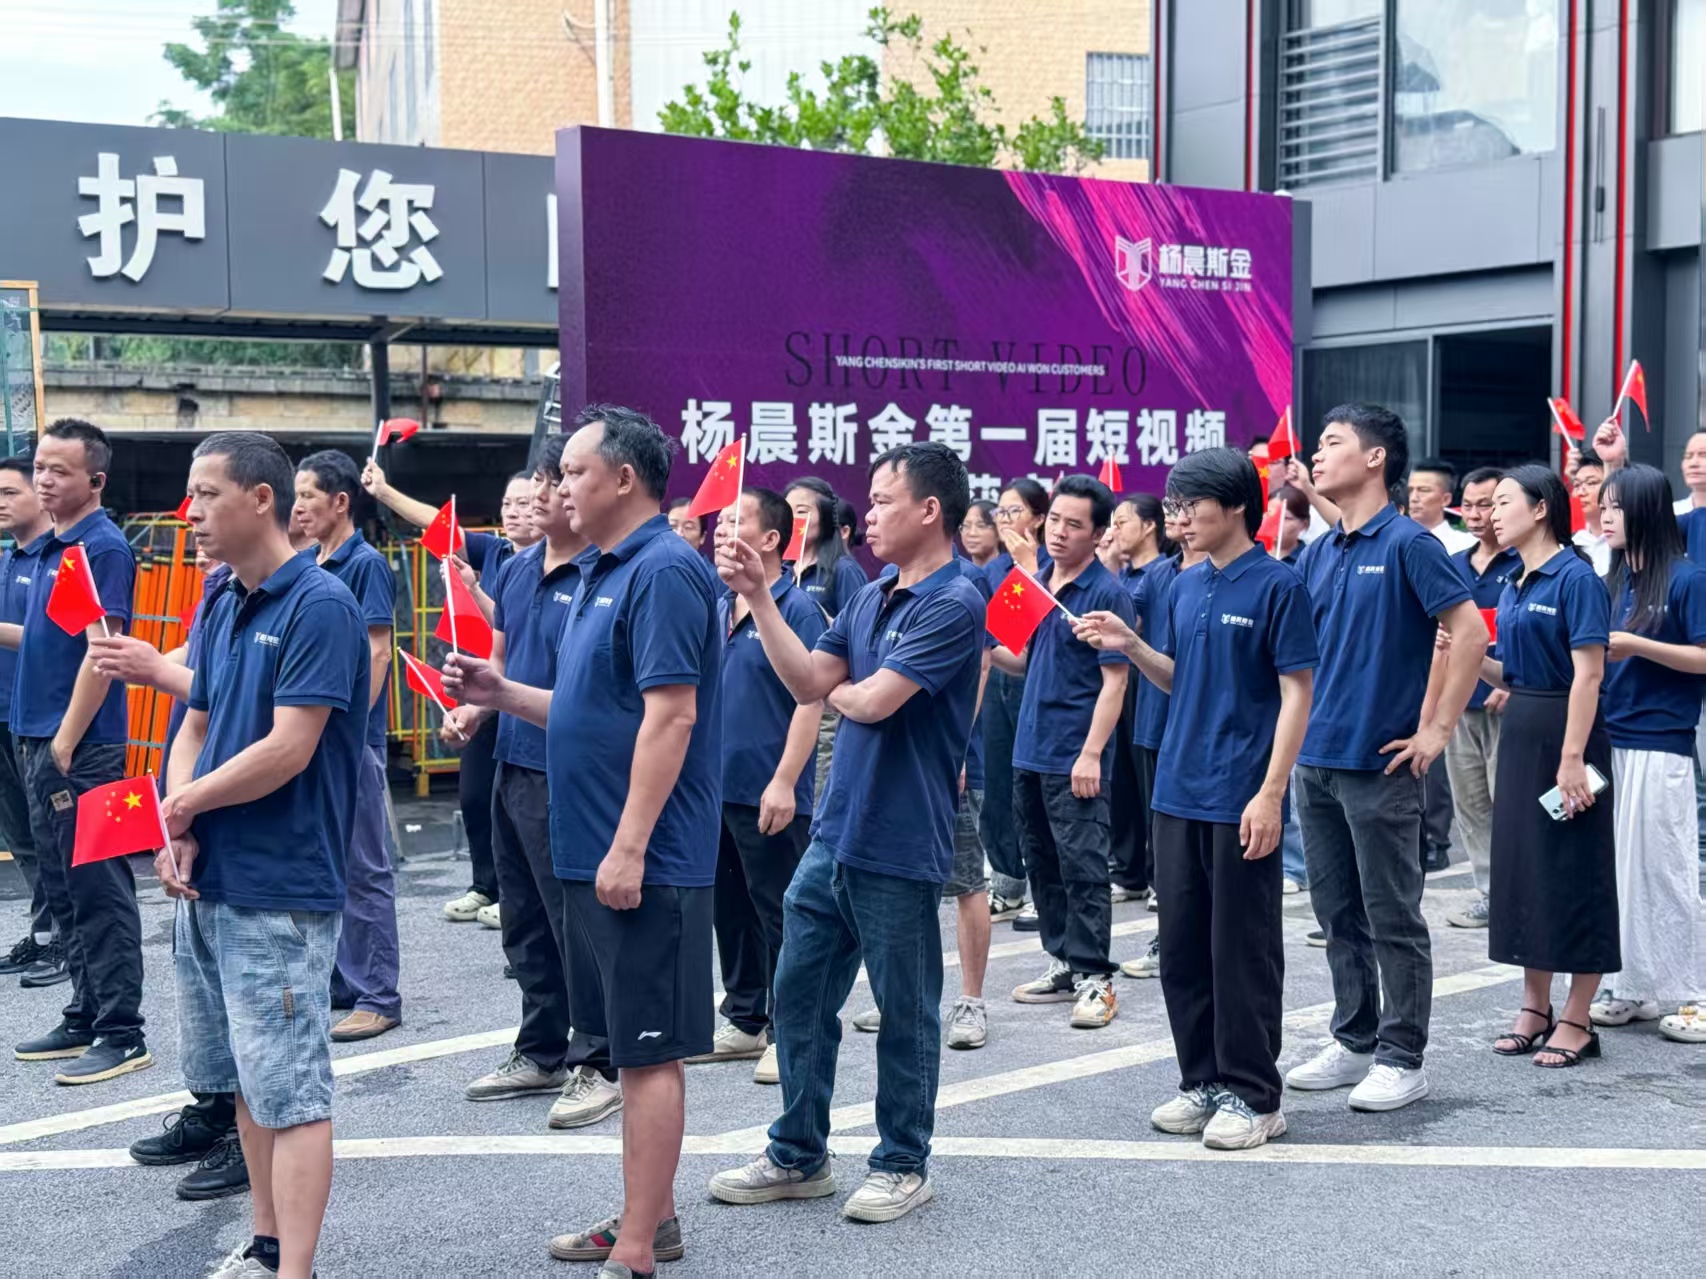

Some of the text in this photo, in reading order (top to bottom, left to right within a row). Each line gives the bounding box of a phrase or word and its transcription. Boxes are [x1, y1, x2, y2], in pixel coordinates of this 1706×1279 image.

[77, 152, 559, 290] 护您
[1158, 244, 1252, 279] 杨晨斯金
[1160, 278, 1252, 292] YANG CHEN SI JIN
[785, 331, 1147, 397] SHORT VIDEO
[835, 355, 863, 368] YANG
[927, 359, 953, 371] FIRST
[954, 360, 986, 372] SHORT
[987, 361, 1016, 373] VIDEO
[1017, 363, 1026, 373] AI
[1027, 363, 1050, 374] WON
[1051, 364, 1105, 376] CUSTOMERS
[680, 398, 1226, 467] 杨晨斯金第一届短视频
